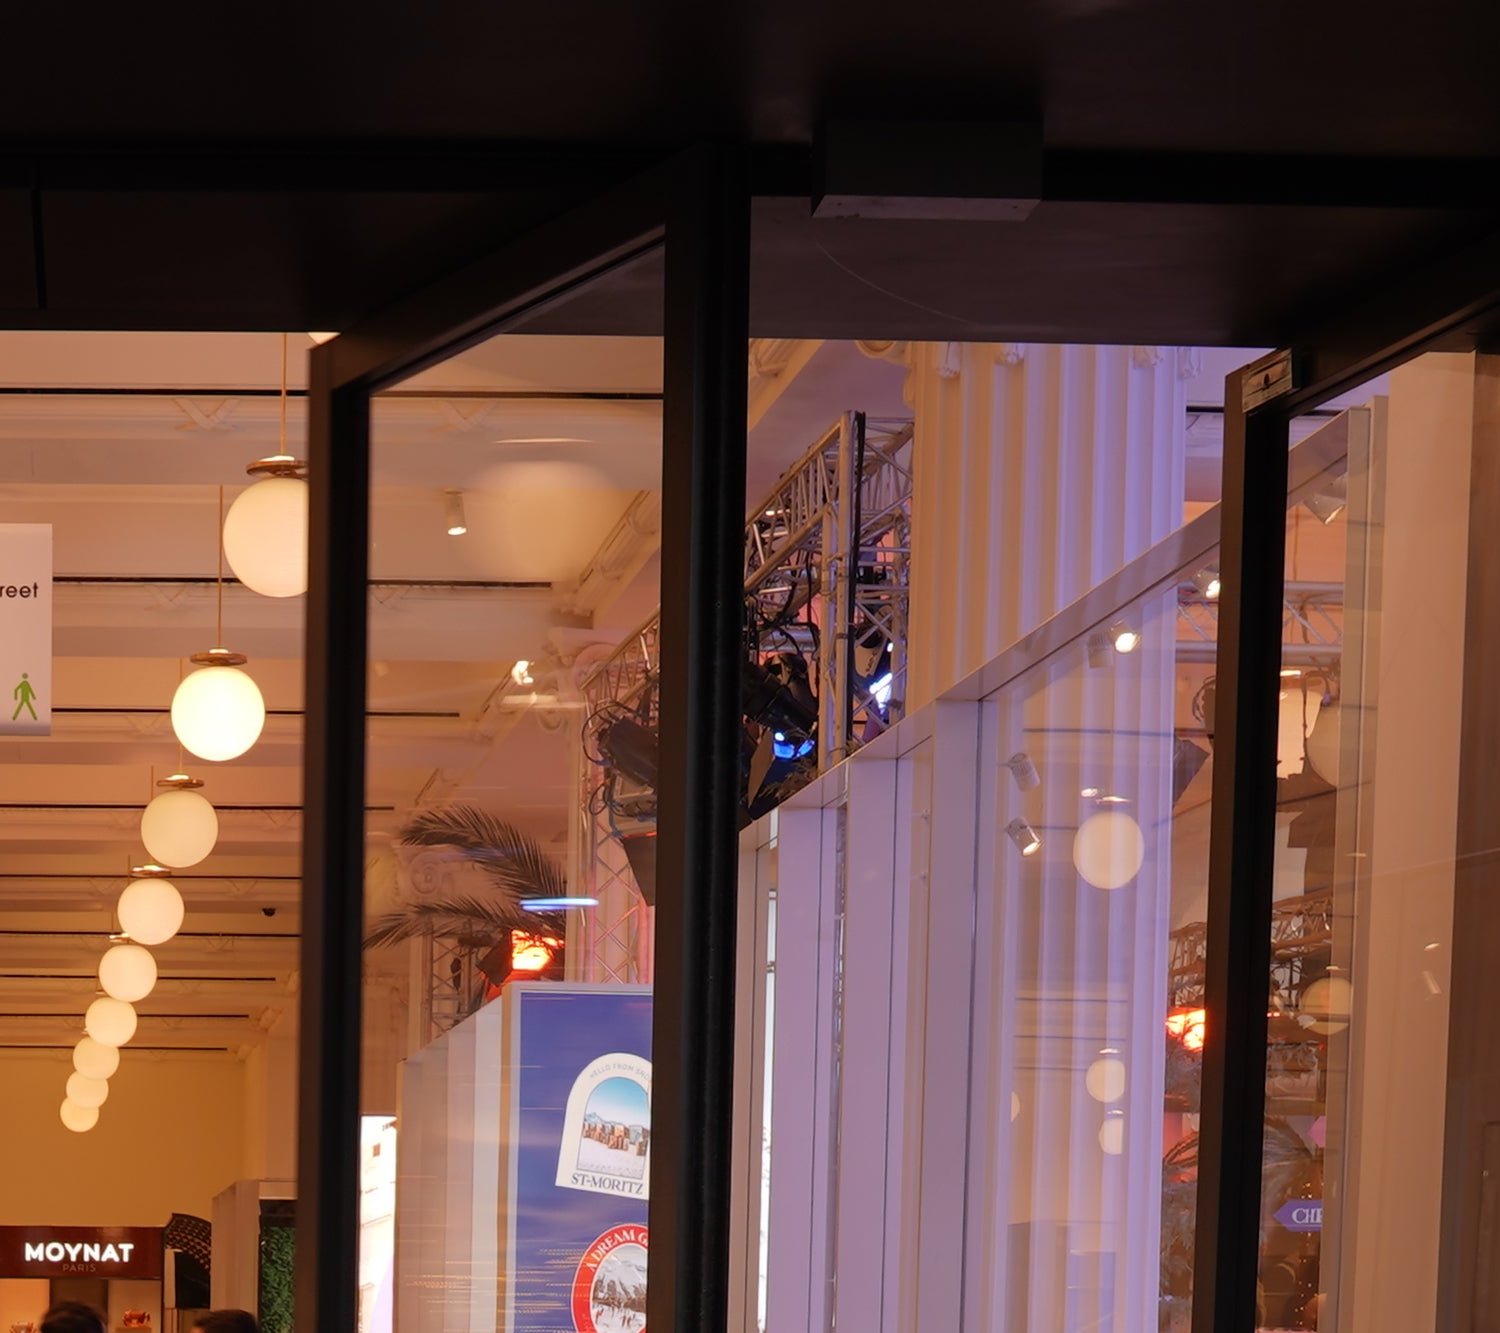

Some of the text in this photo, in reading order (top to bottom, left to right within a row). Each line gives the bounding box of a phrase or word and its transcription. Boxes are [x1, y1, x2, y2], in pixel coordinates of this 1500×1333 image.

[613, 1063, 634, 1072] FROM
[635, 1067, 651, 1081] SNO
[571, 1172, 644, 1195] ST-MORITZ
[24, 1241, 134, 1262] MOYNAT
[586, 1229, 649, 1273] A DREAM G
[62, 1263, 97, 1273] PARIS
